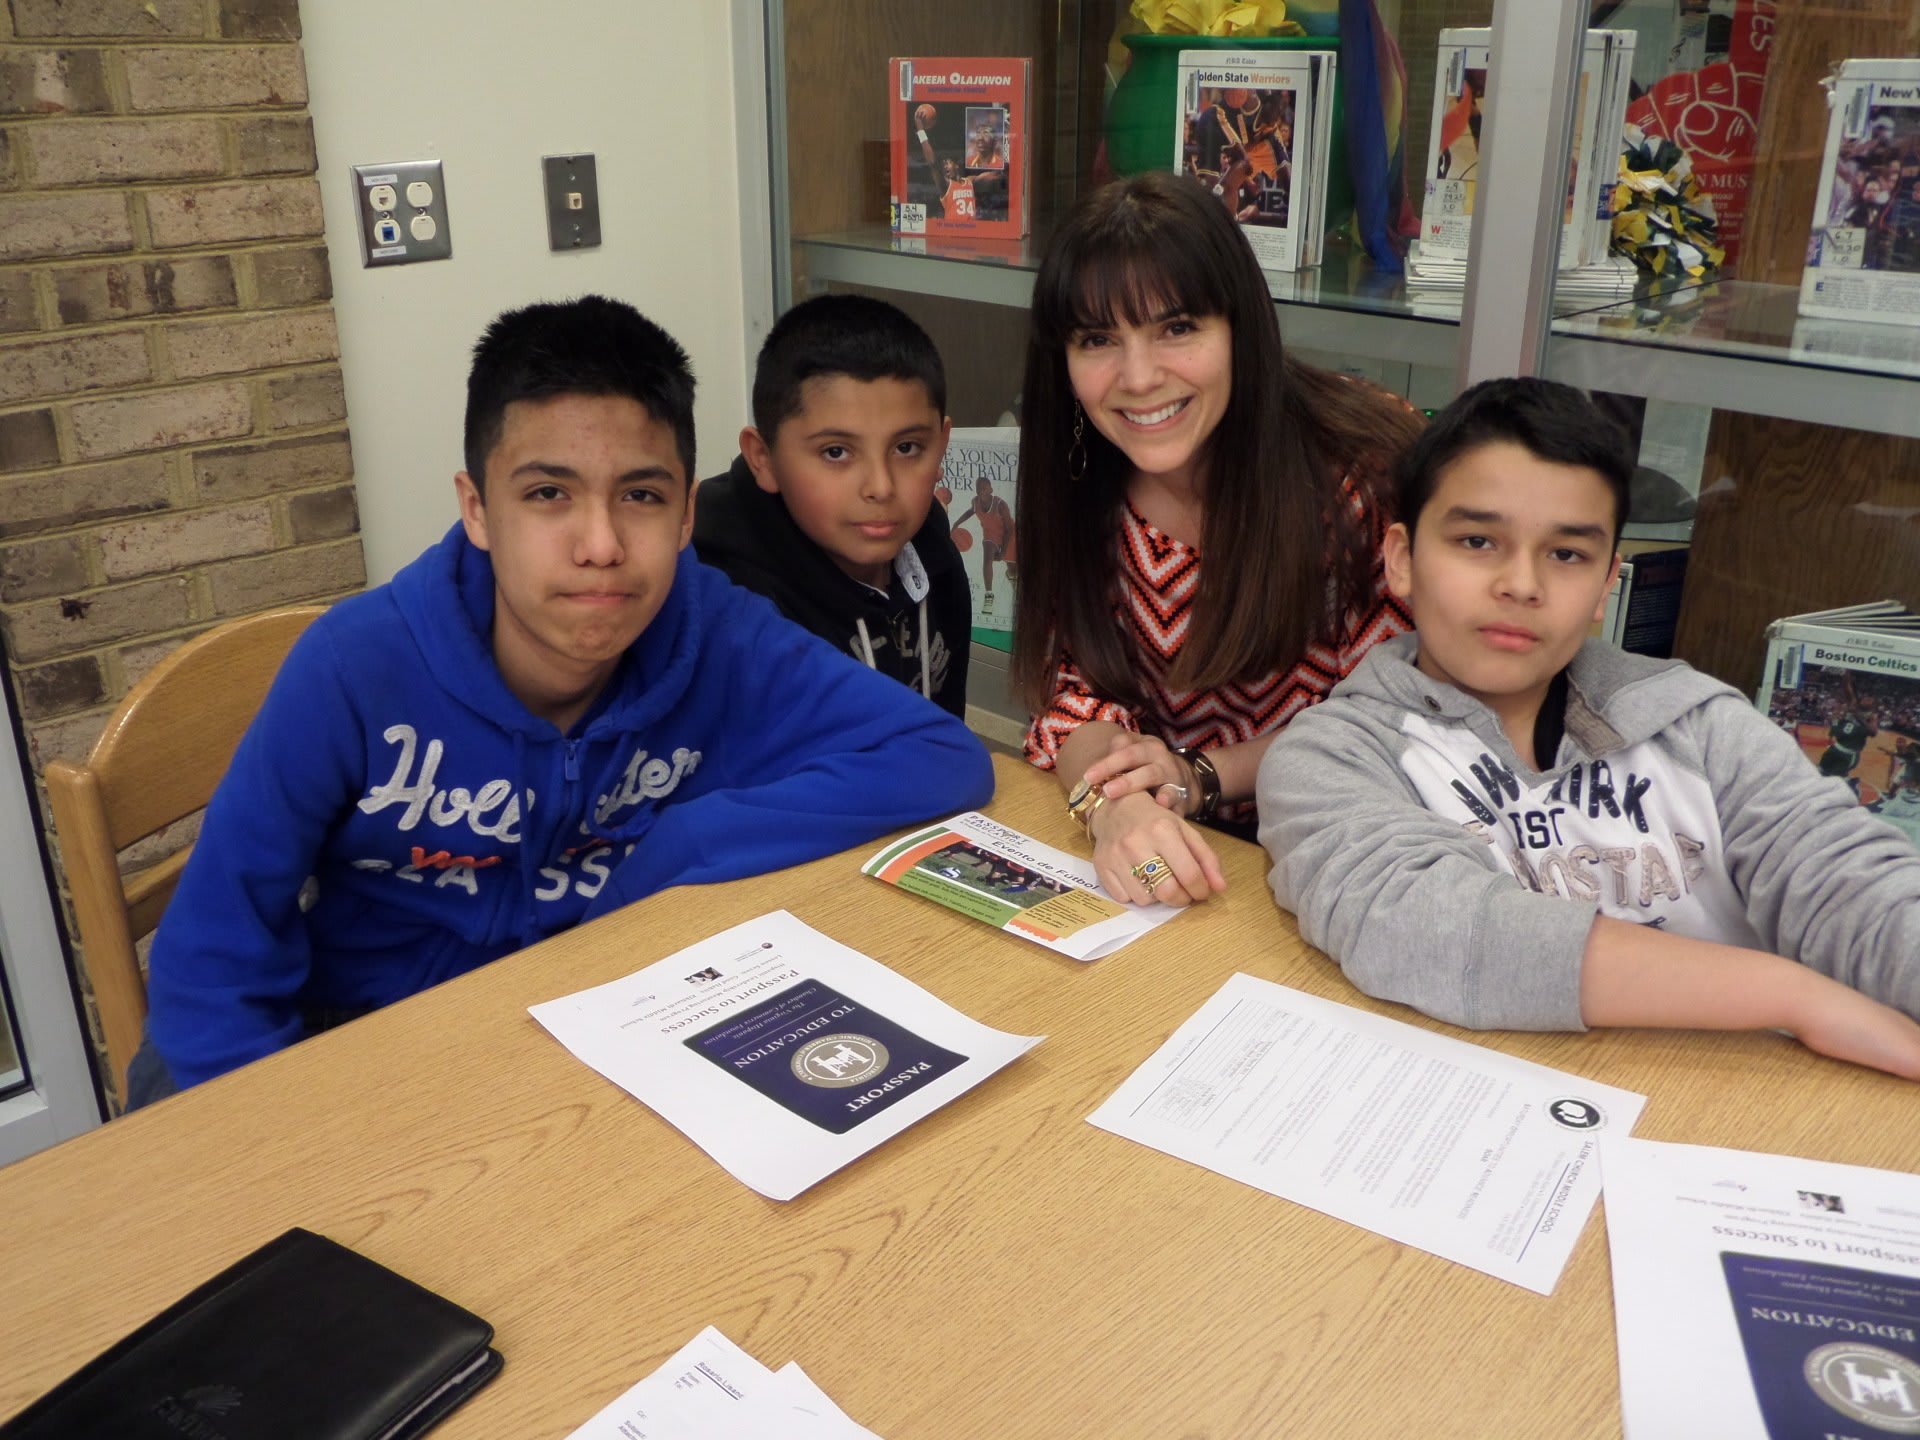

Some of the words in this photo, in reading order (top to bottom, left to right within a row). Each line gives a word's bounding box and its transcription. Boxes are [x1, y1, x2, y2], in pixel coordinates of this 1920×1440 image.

[912, 75, 946, 85] AKEEM
[949, 72, 1012, 86] OLAJUWON
[1198, 71, 1223, 82] olden
[1224, 72, 1249, 83] State
[1250, 73, 1291, 84] Warriors
[1880, 86, 1913, 98] New
[959, 448, 1018, 466] YOUNG
[944, 461, 1018, 482] KETBALL
[938, 476, 973, 491] AYER
[1815, 649, 1865, 665] Boston
[1867, 655, 1917, 673] Celtics
[992, 841, 1036, 863] Evento
[1038, 861, 1054, 870] de
[735, 969, 800, 1001] Passport
[719, 998, 736, 1008] to
[832, 1004, 856, 1018] TO
[660, 1005, 719, 1033] Success
[734, 1017, 831, 1069] EDUCATION
[845, 1061, 933, 1112] PASSPORT
[1540, 1207, 1560, 1234] SCHOOL
[1712, 1225, 1800, 1247] Success
[1804, 1237, 1829, 1251] to
[1835, 1241, 1920, 1266] assport
[1751, 1306, 1916, 1342] EDUCATION
